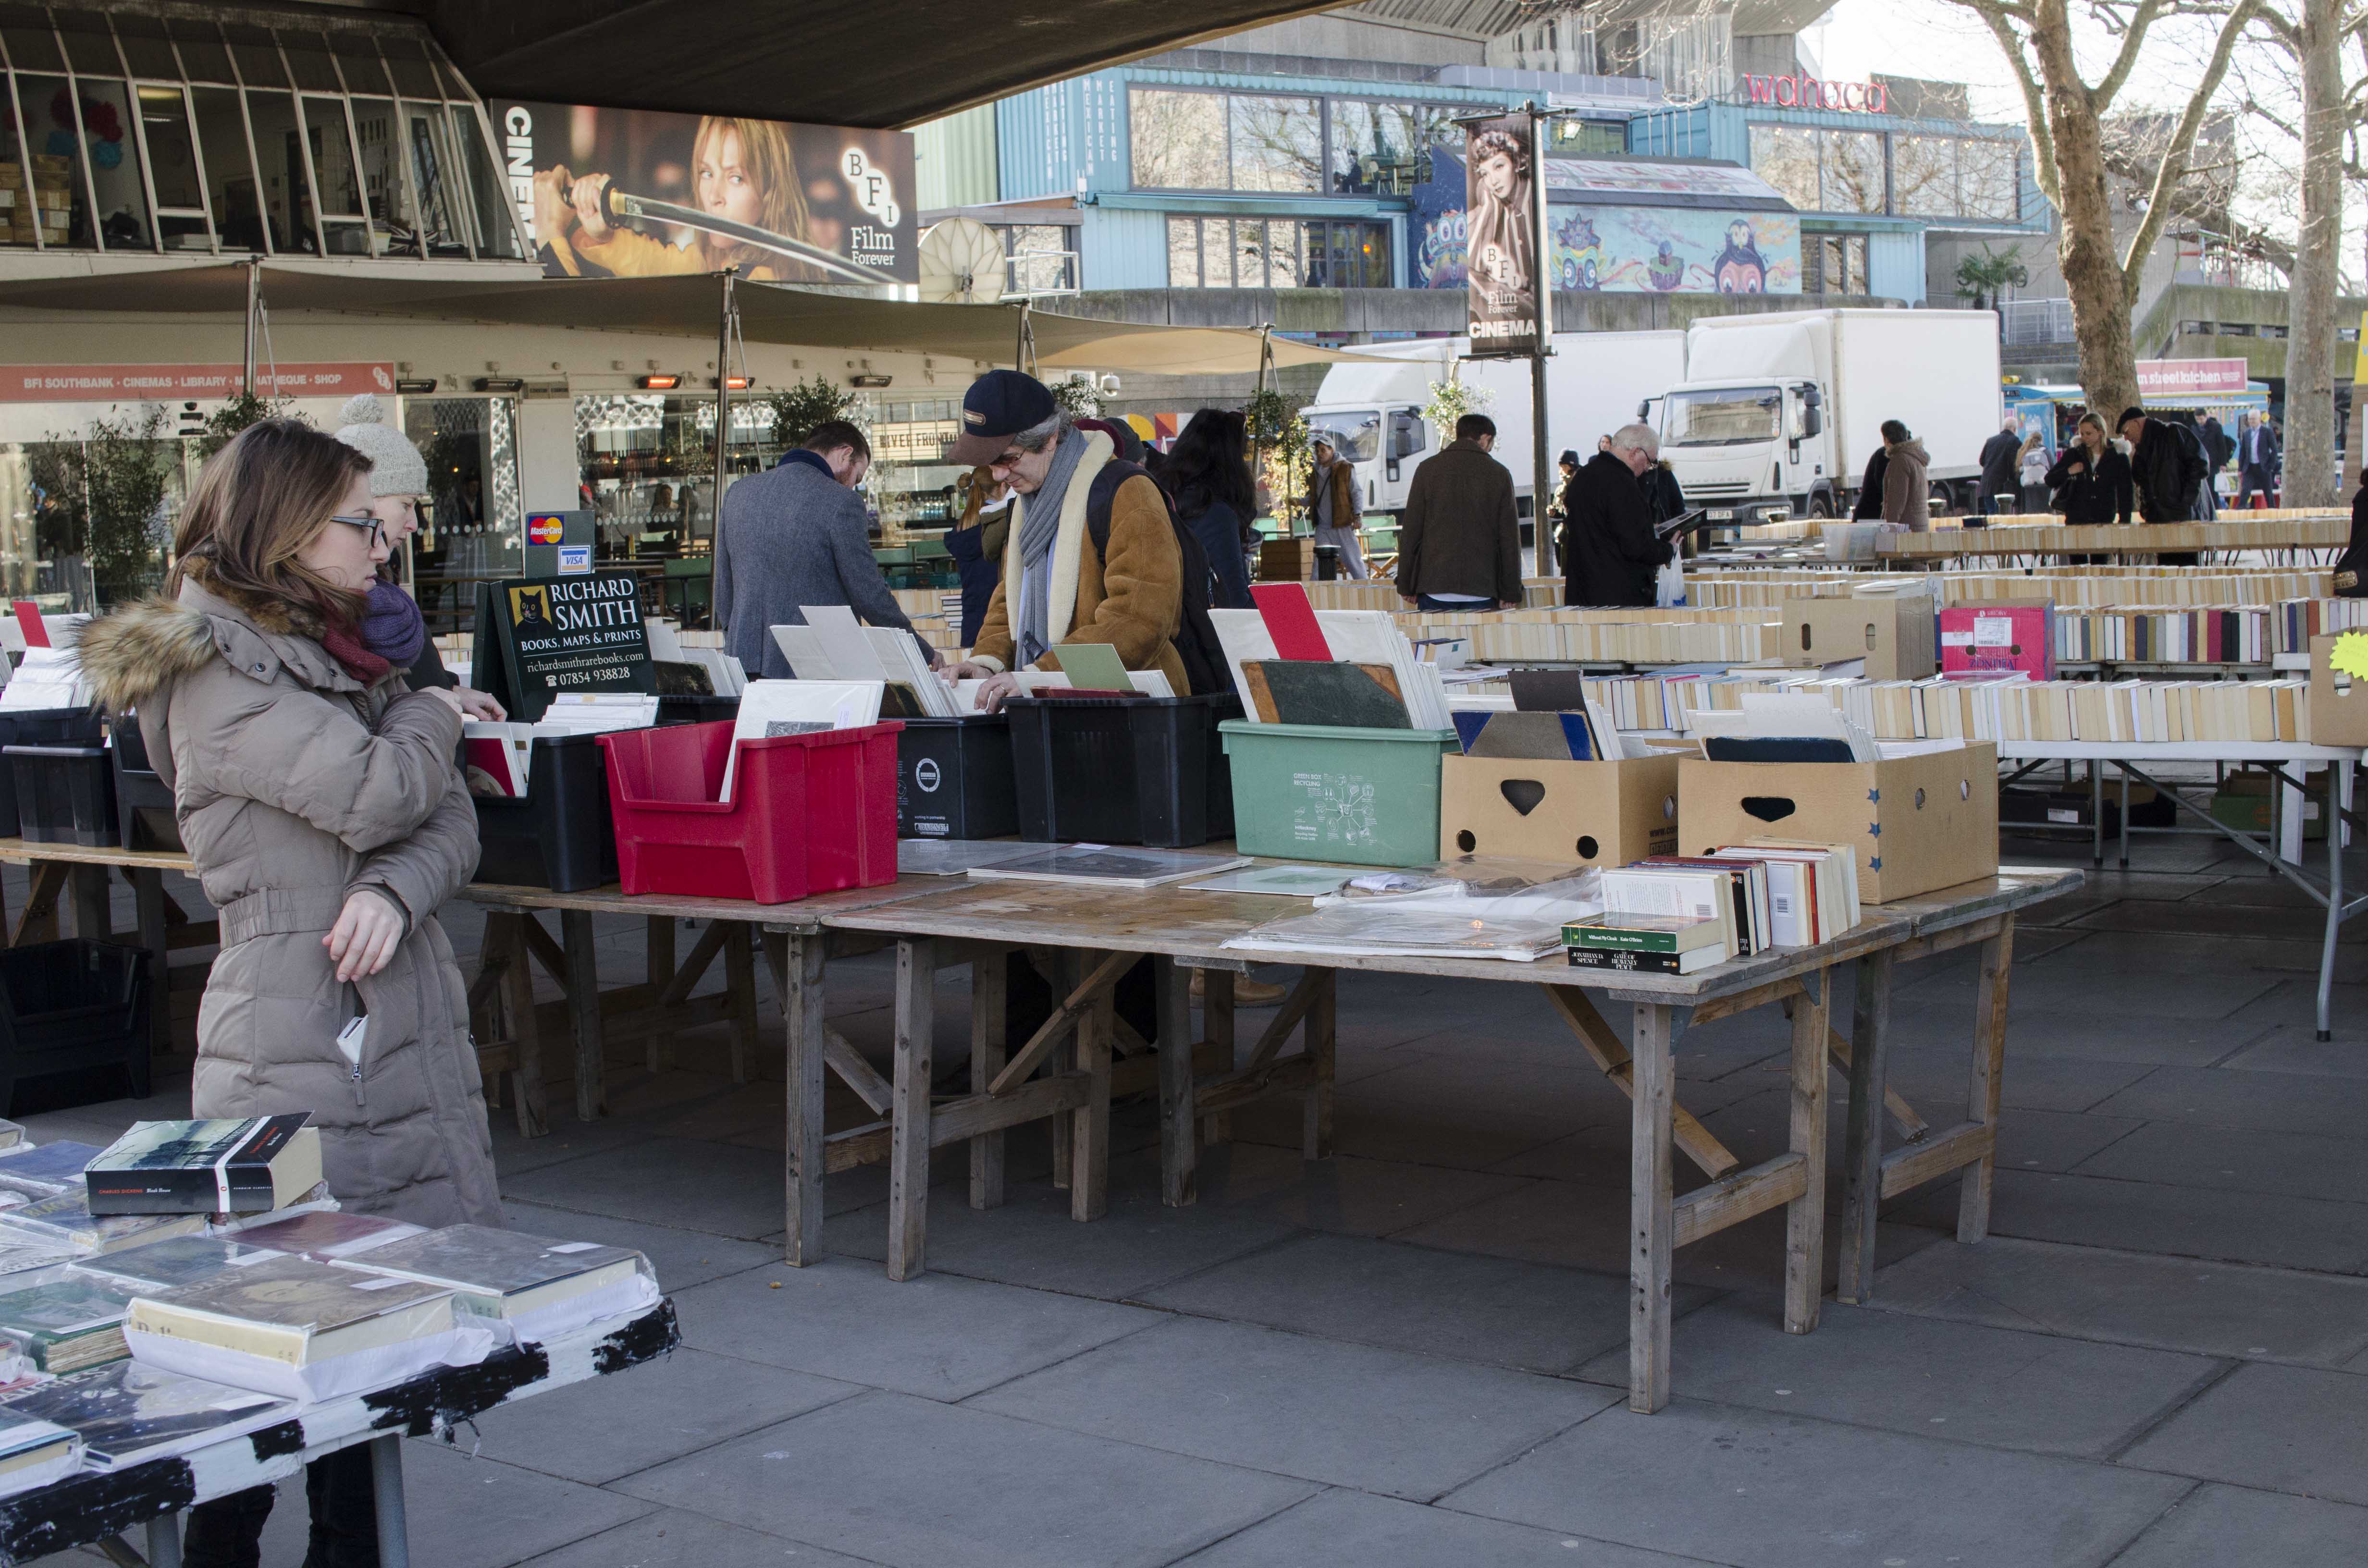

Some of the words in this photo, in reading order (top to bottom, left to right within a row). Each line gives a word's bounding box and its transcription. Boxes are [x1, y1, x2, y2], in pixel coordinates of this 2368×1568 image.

[1745, 69, 1886, 113] wahaca
[1084, 79, 1094, 176] MEXICAN
[1096, 80, 1105, 161] MARKET
[1109, 80, 1117, 161] EATING
[851, 225, 895, 250] Film
[852, 251, 895, 266] Forever
[1488, 290, 1518, 305] Film
[1488, 305, 1517, 314] Forever
[1469, 319, 1537, 339] CINEMA
[24, 378, 42, 389] BFI
[45, 377, 114, 389] SOUTHBANK
[123, 377, 173, 388] CINEMAS
[181, 376, 226, 387] LIBRARY
[314, 374, 342, 384] SHOP
[2180, 369, 2221, 384] kitchen
[530, 527, 562, 535] MasterCard
[566, 556, 583, 565] VISA
[550, 578, 634, 602] RICHARD
[555, 600, 639, 631] SMITH
[521, 638, 560, 651] BOOKS,
[563, 634, 591, 647] MAPS
[593, 632, 602, 644] &
[604, 629, 641, 642] PRINTS
[527, 652, 644, 673] richardsmithrarebooks.com
[559, 672, 591, 686] 07854
[593, 667, 630, 681] 938828
[1577, 956, 1598, 965] SPENCE
